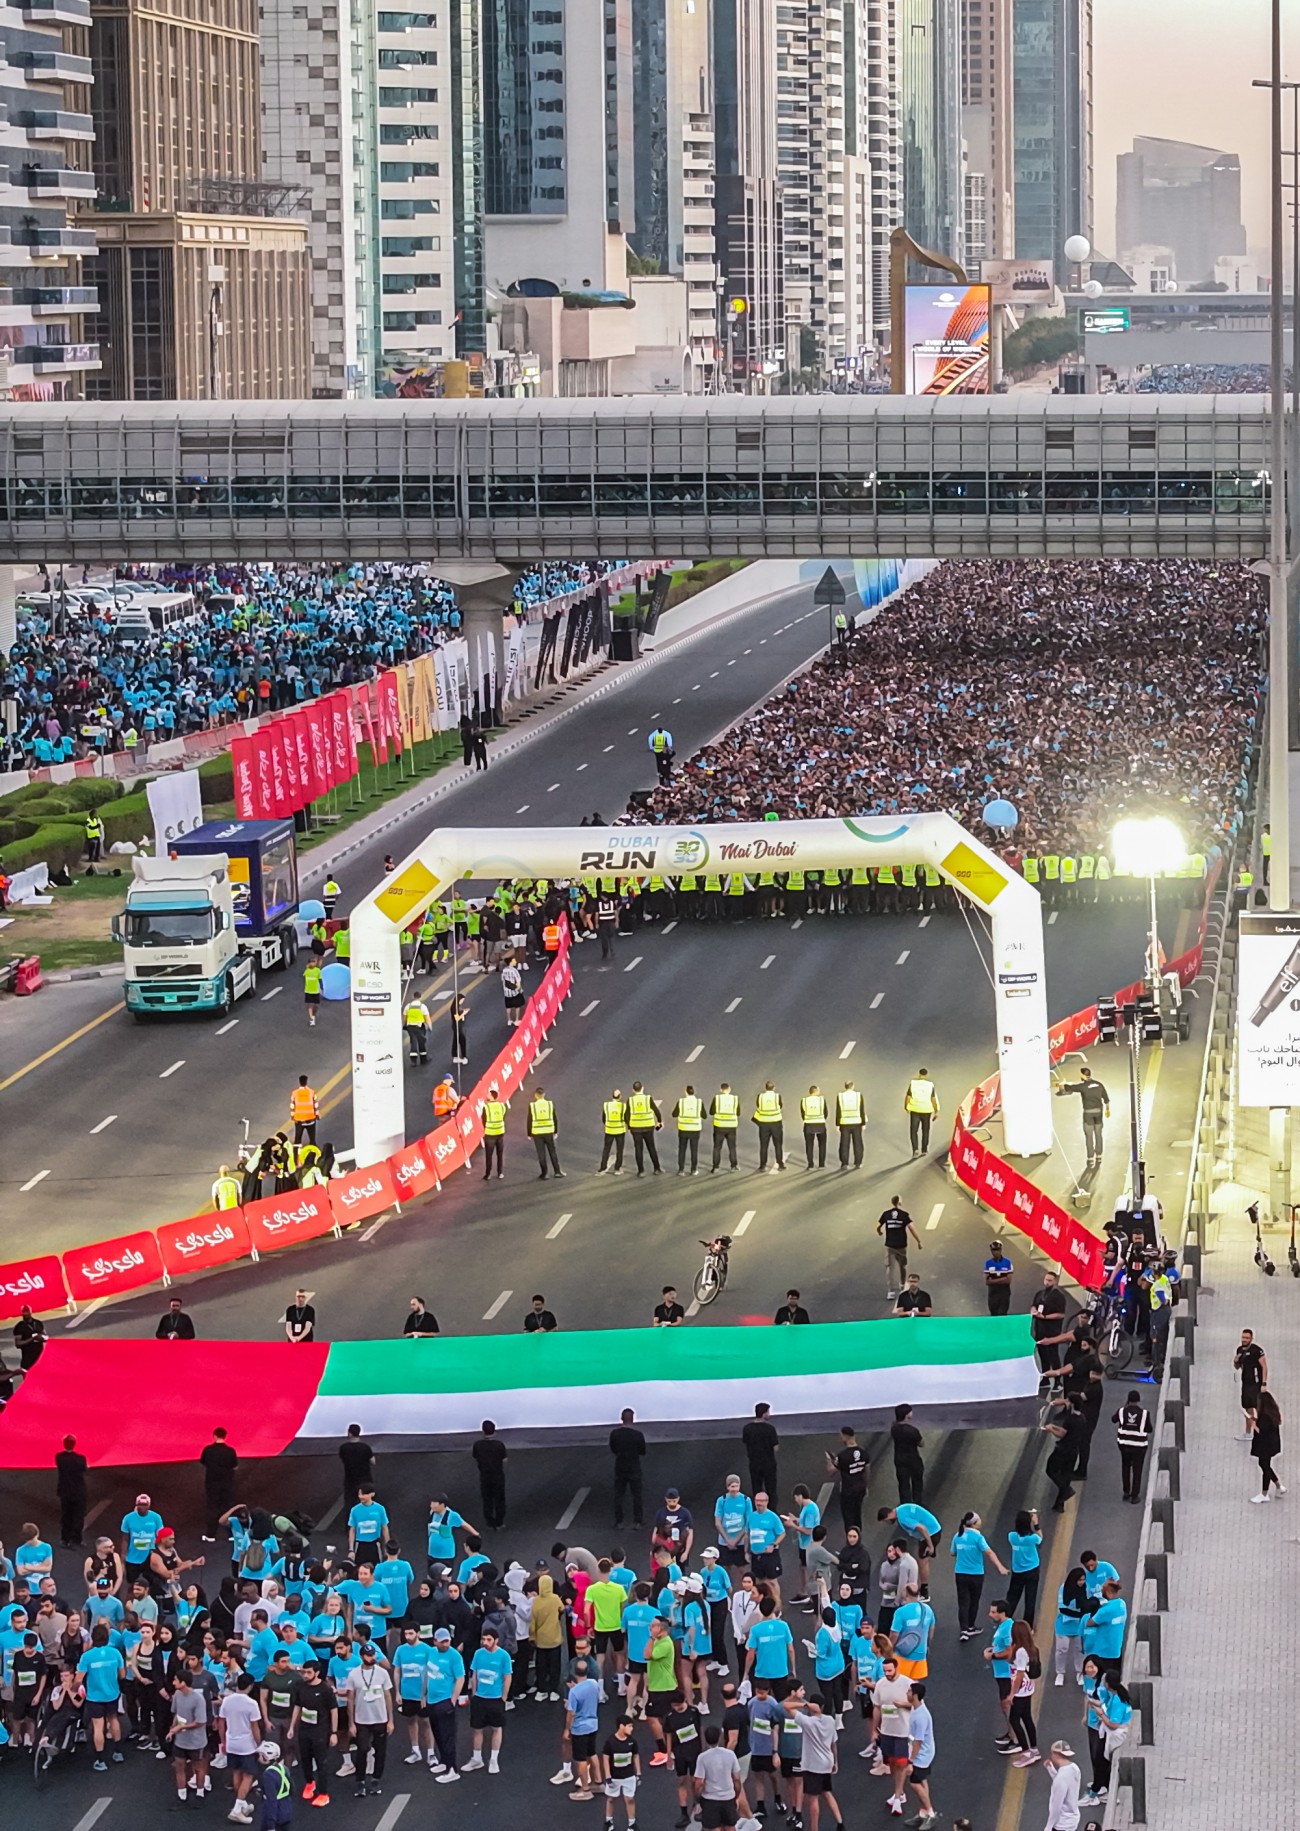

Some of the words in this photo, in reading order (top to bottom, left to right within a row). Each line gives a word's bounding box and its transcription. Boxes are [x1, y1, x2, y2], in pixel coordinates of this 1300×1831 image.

[581, 609, 593, 649] WHOOP
[609, 836, 659, 848] DUBAI
[675, 841, 700, 851] 30
[720, 842, 751, 860] Mai
[754, 839, 797, 859] Dubai
[580, 851, 656, 871] RUN
[360, 961, 381, 971] AWR
[341, 1186, 361, 1205] دبي
[361, 1177, 383, 1198] ماي
[262, 1210, 290, 1231] دبي
[290, 1201, 318, 1223] ماي
[175, 1232, 204, 1254] دبي
[204, 1223, 235, 1247] ماي
[82, 1257, 113, 1280] دبي
[112, 1248, 144, 1273] ماي
[7, 1272, 44, 1296] ماي
